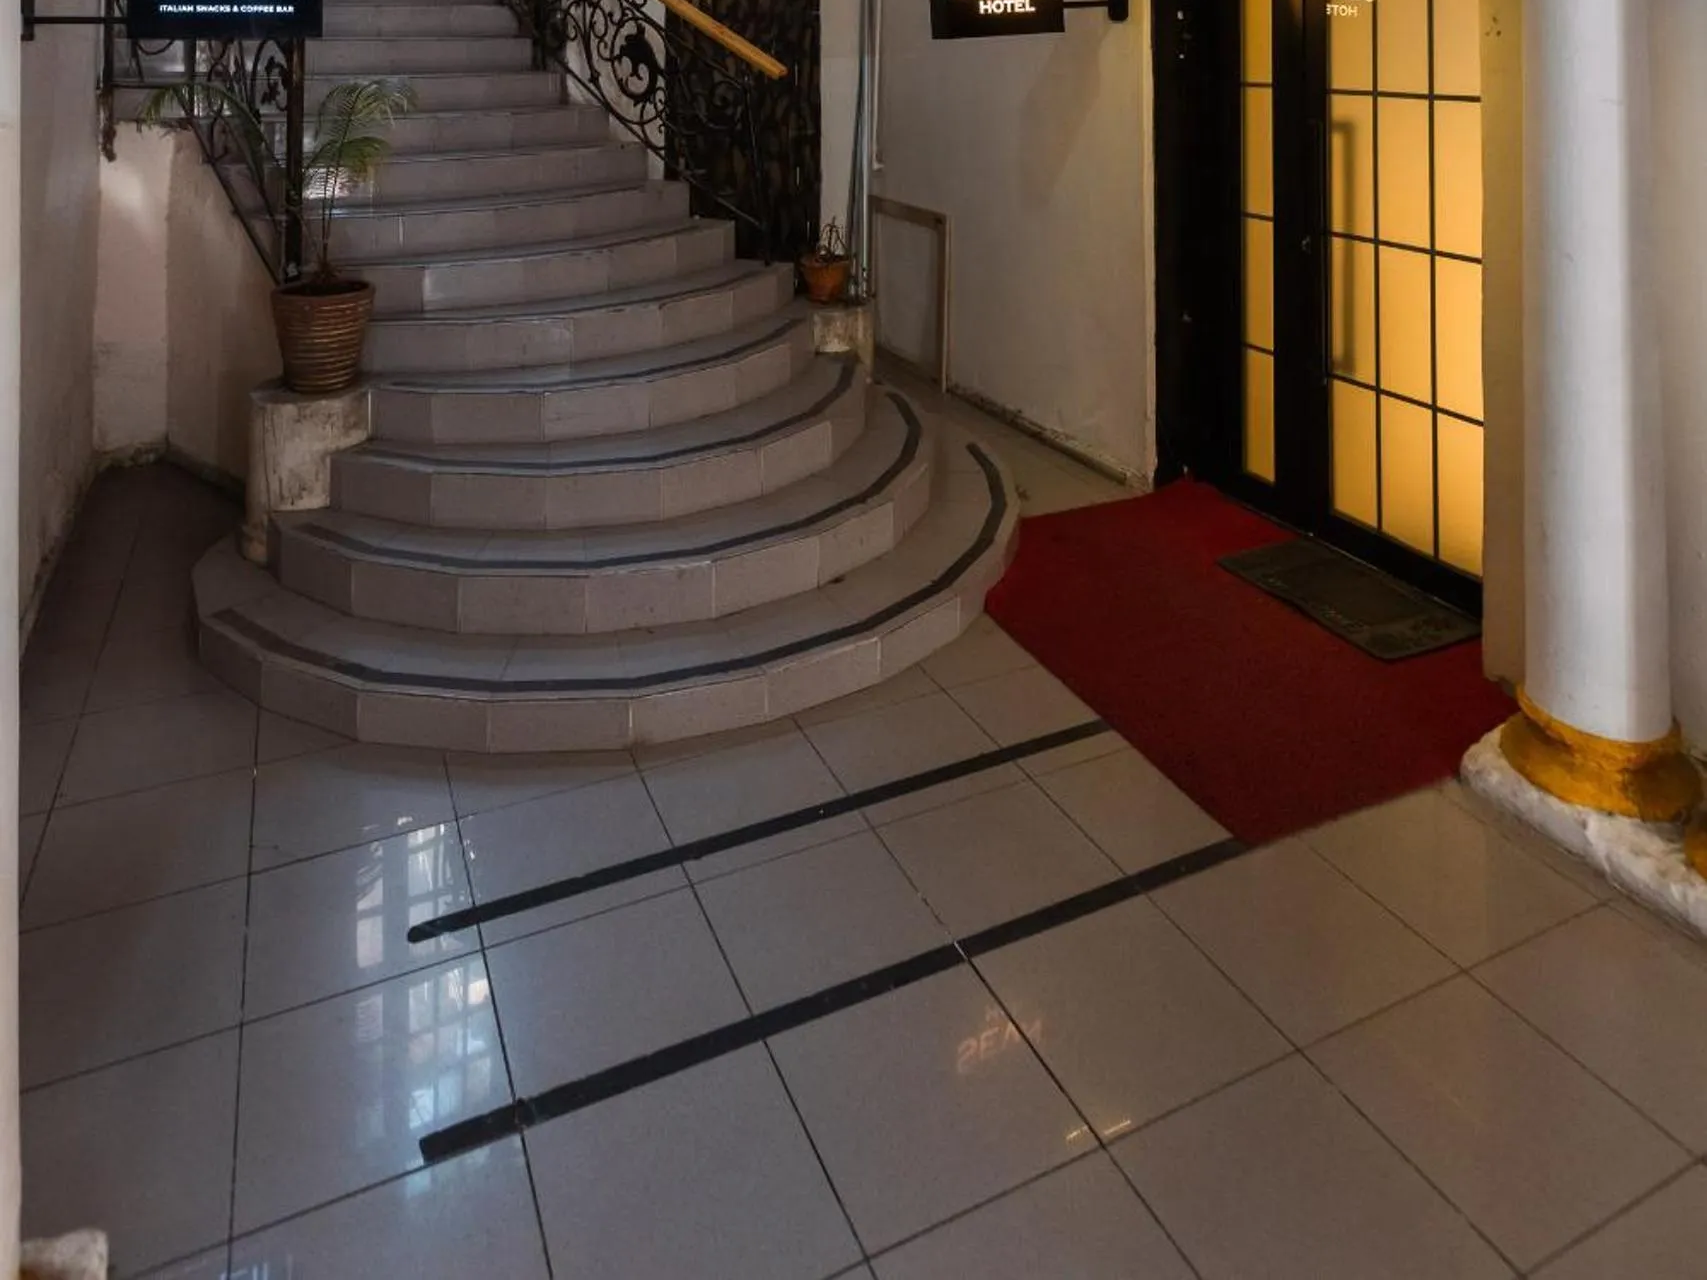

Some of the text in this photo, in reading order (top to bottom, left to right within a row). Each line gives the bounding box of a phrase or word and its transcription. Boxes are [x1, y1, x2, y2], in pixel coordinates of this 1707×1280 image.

[159, 4, 294, 13] ITALIAN SNACKS & COFFEE BAR
